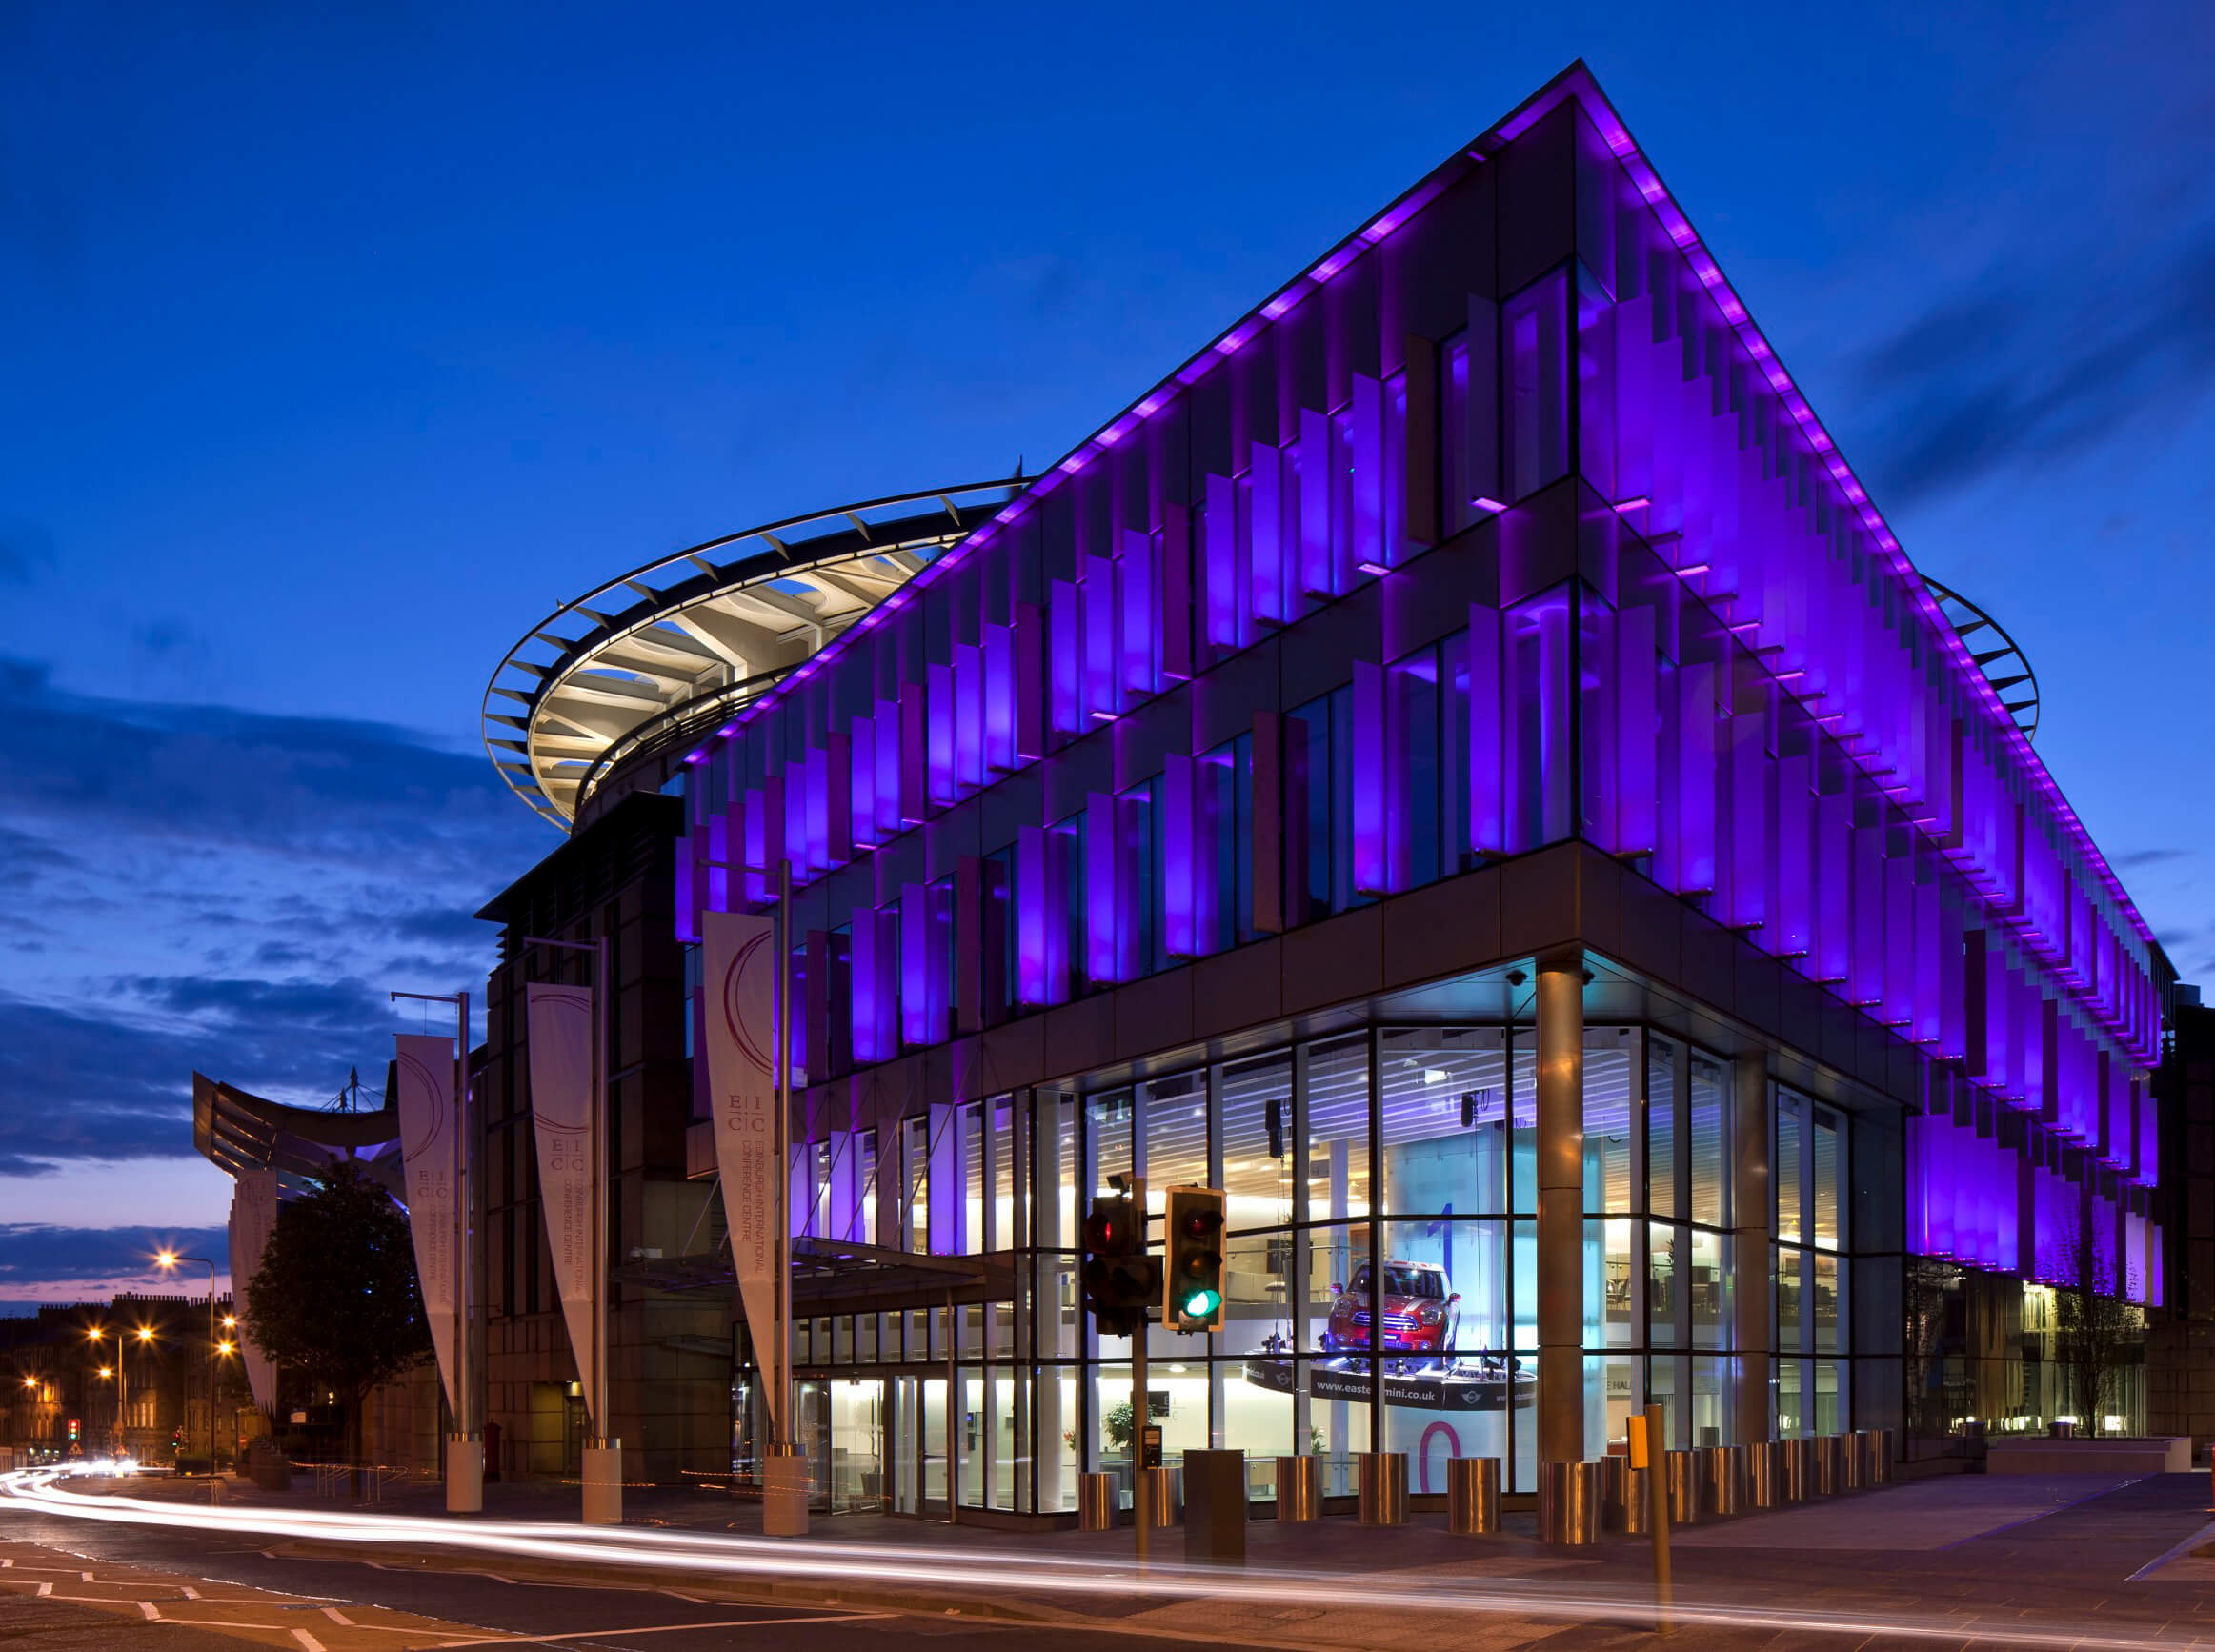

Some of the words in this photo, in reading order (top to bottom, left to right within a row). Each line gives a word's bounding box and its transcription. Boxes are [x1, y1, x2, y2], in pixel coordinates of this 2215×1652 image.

[742, 1140, 752, 1202] CONFERENCE
[755, 1140, 764, 1197] EDINBURGH
[742, 1204, 752, 1242] CENTRE
[755, 1199, 764, 1273] INTERNATIONAL
[1317, 1381, 1435, 1401] www.eastemini.co.uk
